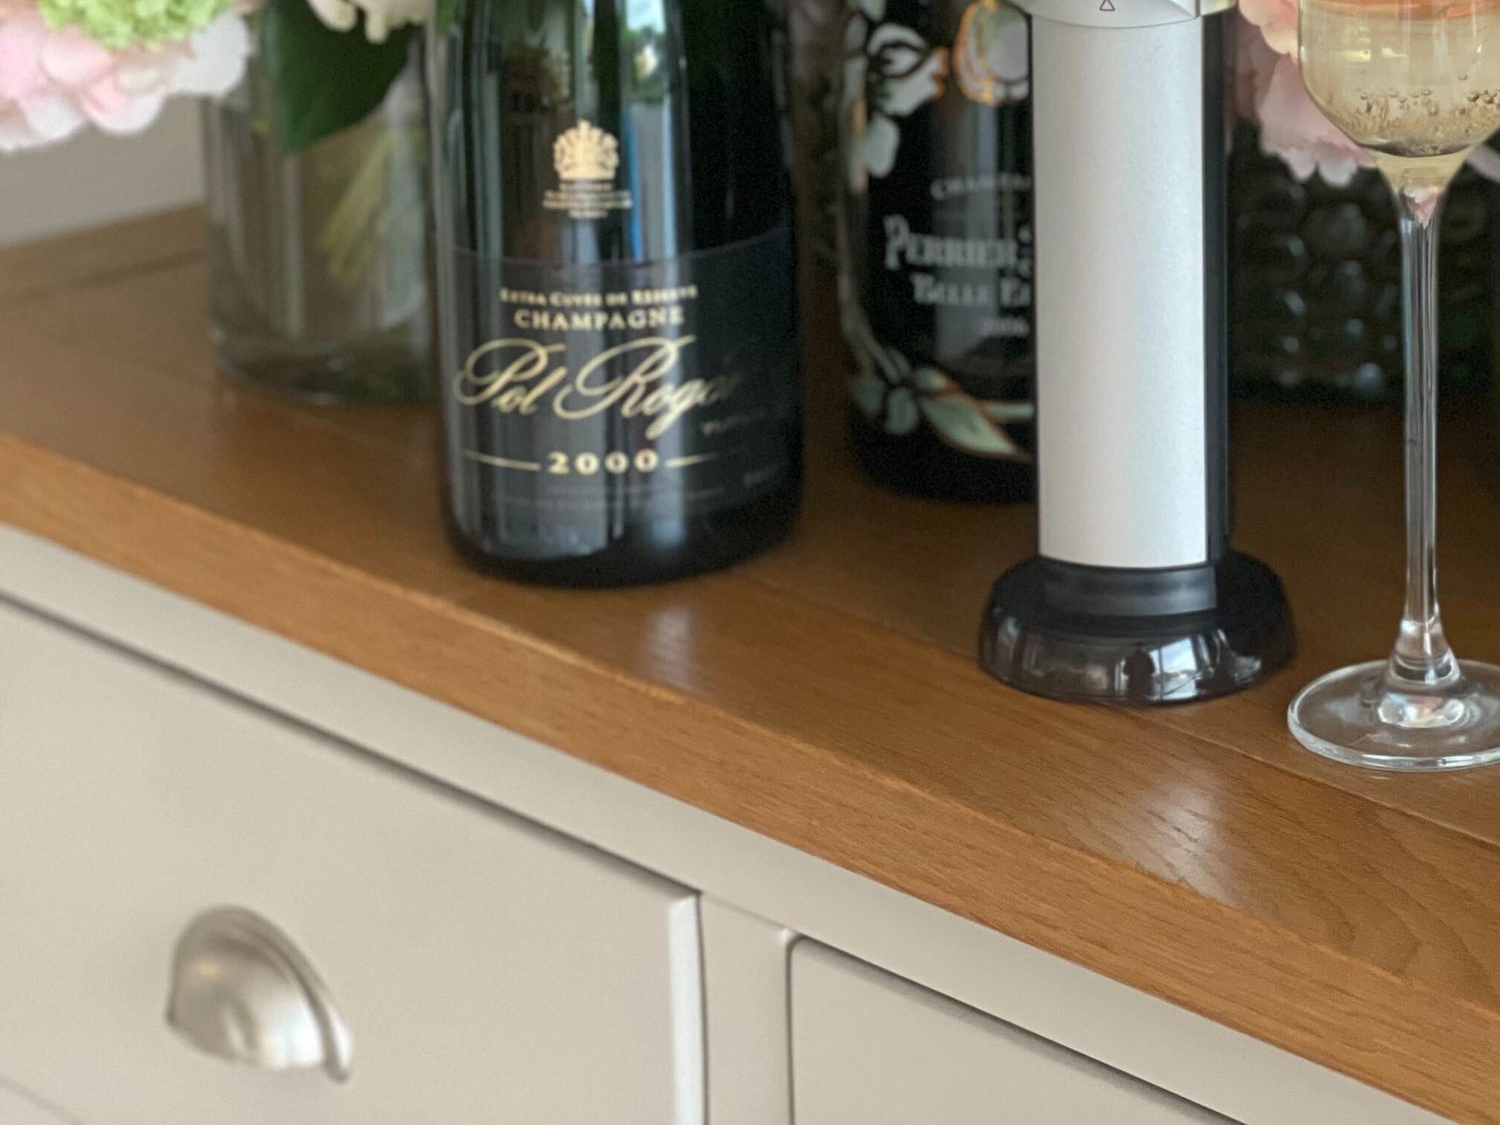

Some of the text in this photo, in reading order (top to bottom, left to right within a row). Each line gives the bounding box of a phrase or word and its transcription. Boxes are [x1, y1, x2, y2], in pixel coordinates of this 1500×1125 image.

[513, 305, 685, 331] CHAMPAGNE
[453, 336, 568, 416] Pol
[548, 449, 659, 475] 2000
